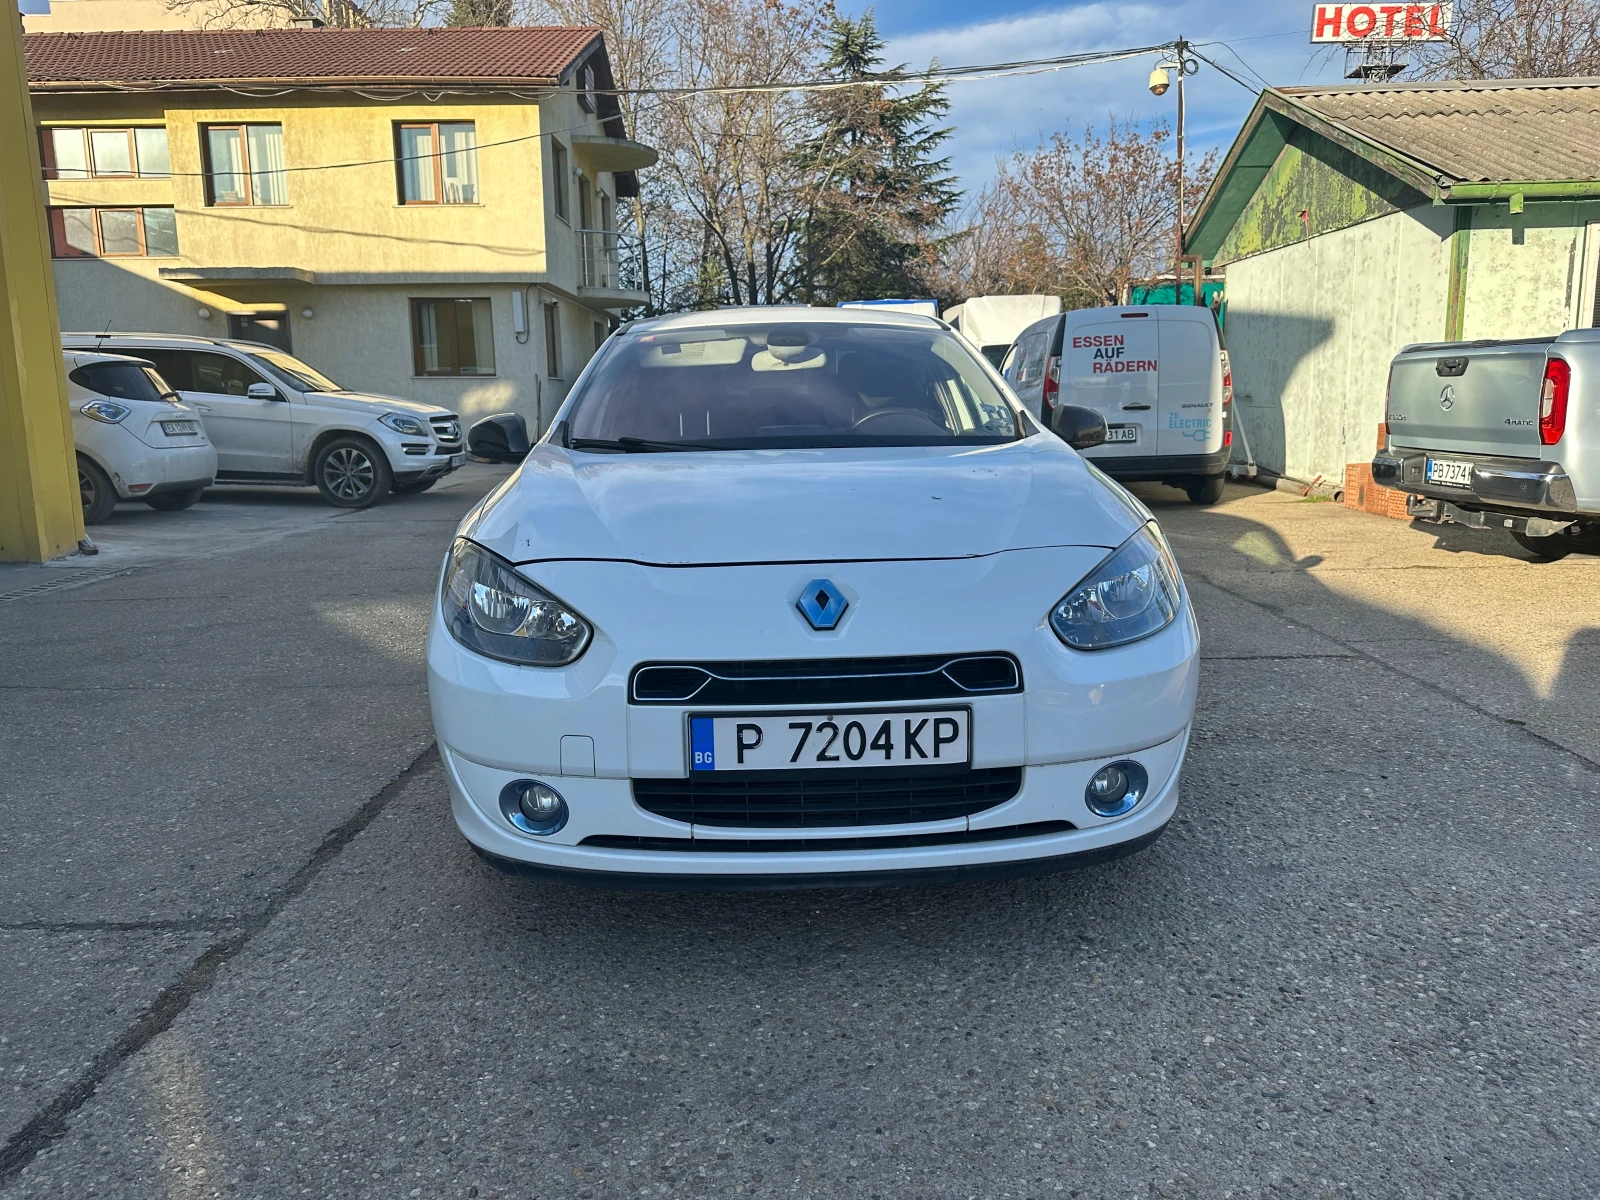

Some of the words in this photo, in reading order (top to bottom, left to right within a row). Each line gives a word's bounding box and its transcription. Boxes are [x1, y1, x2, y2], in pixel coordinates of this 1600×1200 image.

[1315, 6, 1447, 37] HOTEL
[1073, 335, 1124, 348] ESSEN
[1093, 347, 1124, 359] AUF
[1093, 359, 1157, 374] RÄDERN
[1168, 418, 1212, 429] ELECTRIC
[1504, 418, 1534, 426] 4MATIC
[736, 723, 763, 764] P
[694, 752, 712, 764] BG
